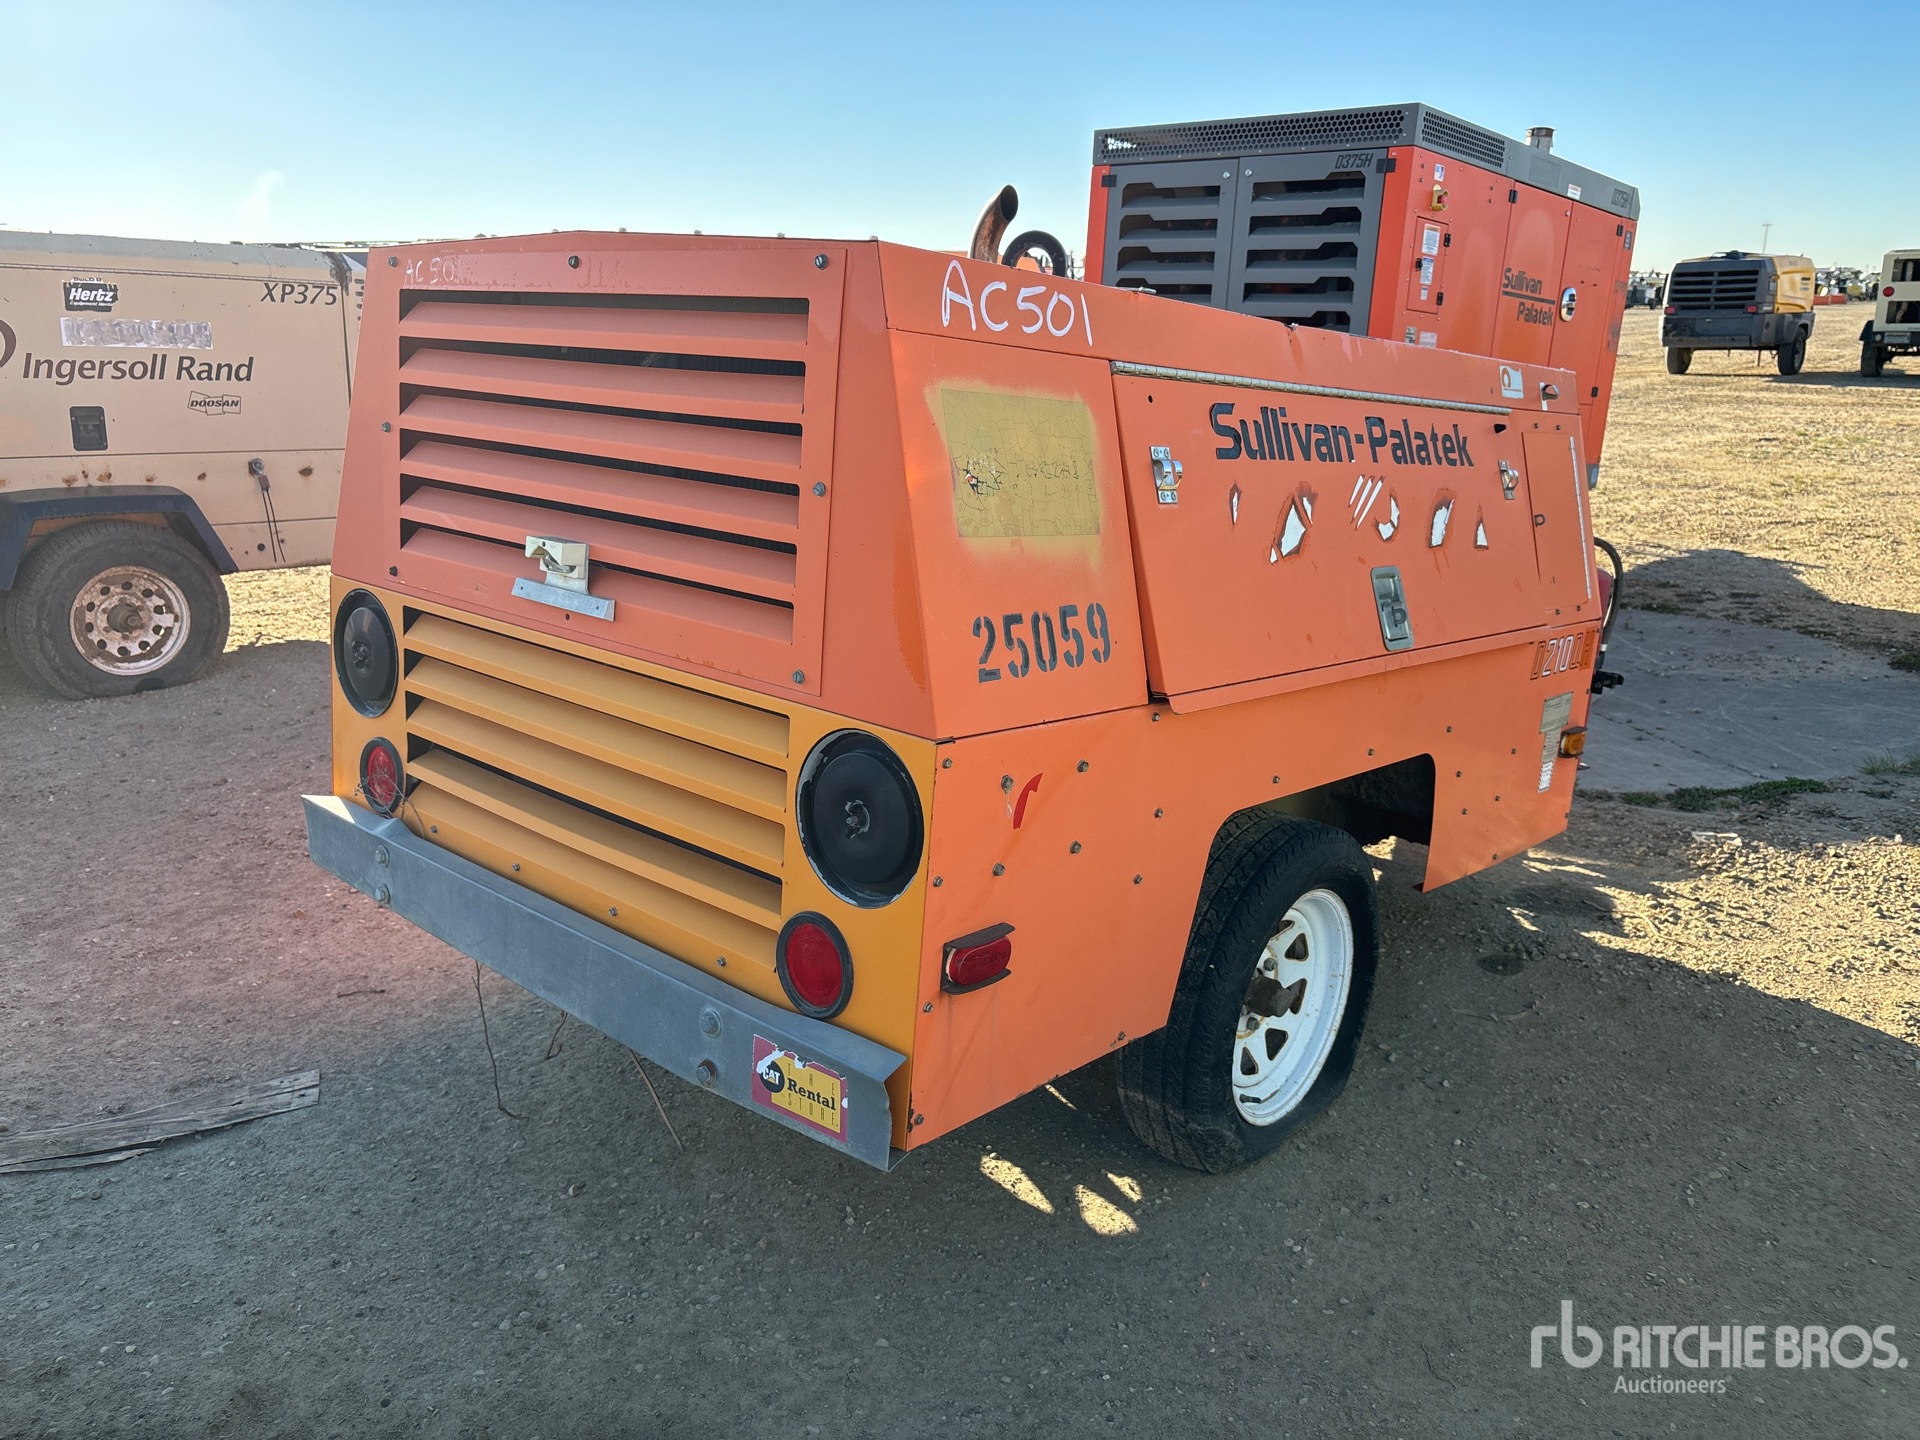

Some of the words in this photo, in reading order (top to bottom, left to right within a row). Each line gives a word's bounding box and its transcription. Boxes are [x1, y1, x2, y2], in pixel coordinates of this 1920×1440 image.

[69, 287, 114, 302] Hertz
[260, 282, 338, 305] XP375
[1502, 267, 1543, 295] Sullivan
[941, 259, 1094, 346] AC501
[1516, 301, 1554, 326] Palatek
[22, 352, 167, 386] Ingersoll
[175, 355, 255, 382] Rand
[189, 398, 240, 409] DOOSAN
[1209, 402, 1474, 468] Sullivan-Palatek
[972, 602, 1111, 683] 25059
[762, 1067, 781, 1086] CAT
[787, 1077, 836, 1111] Rental
